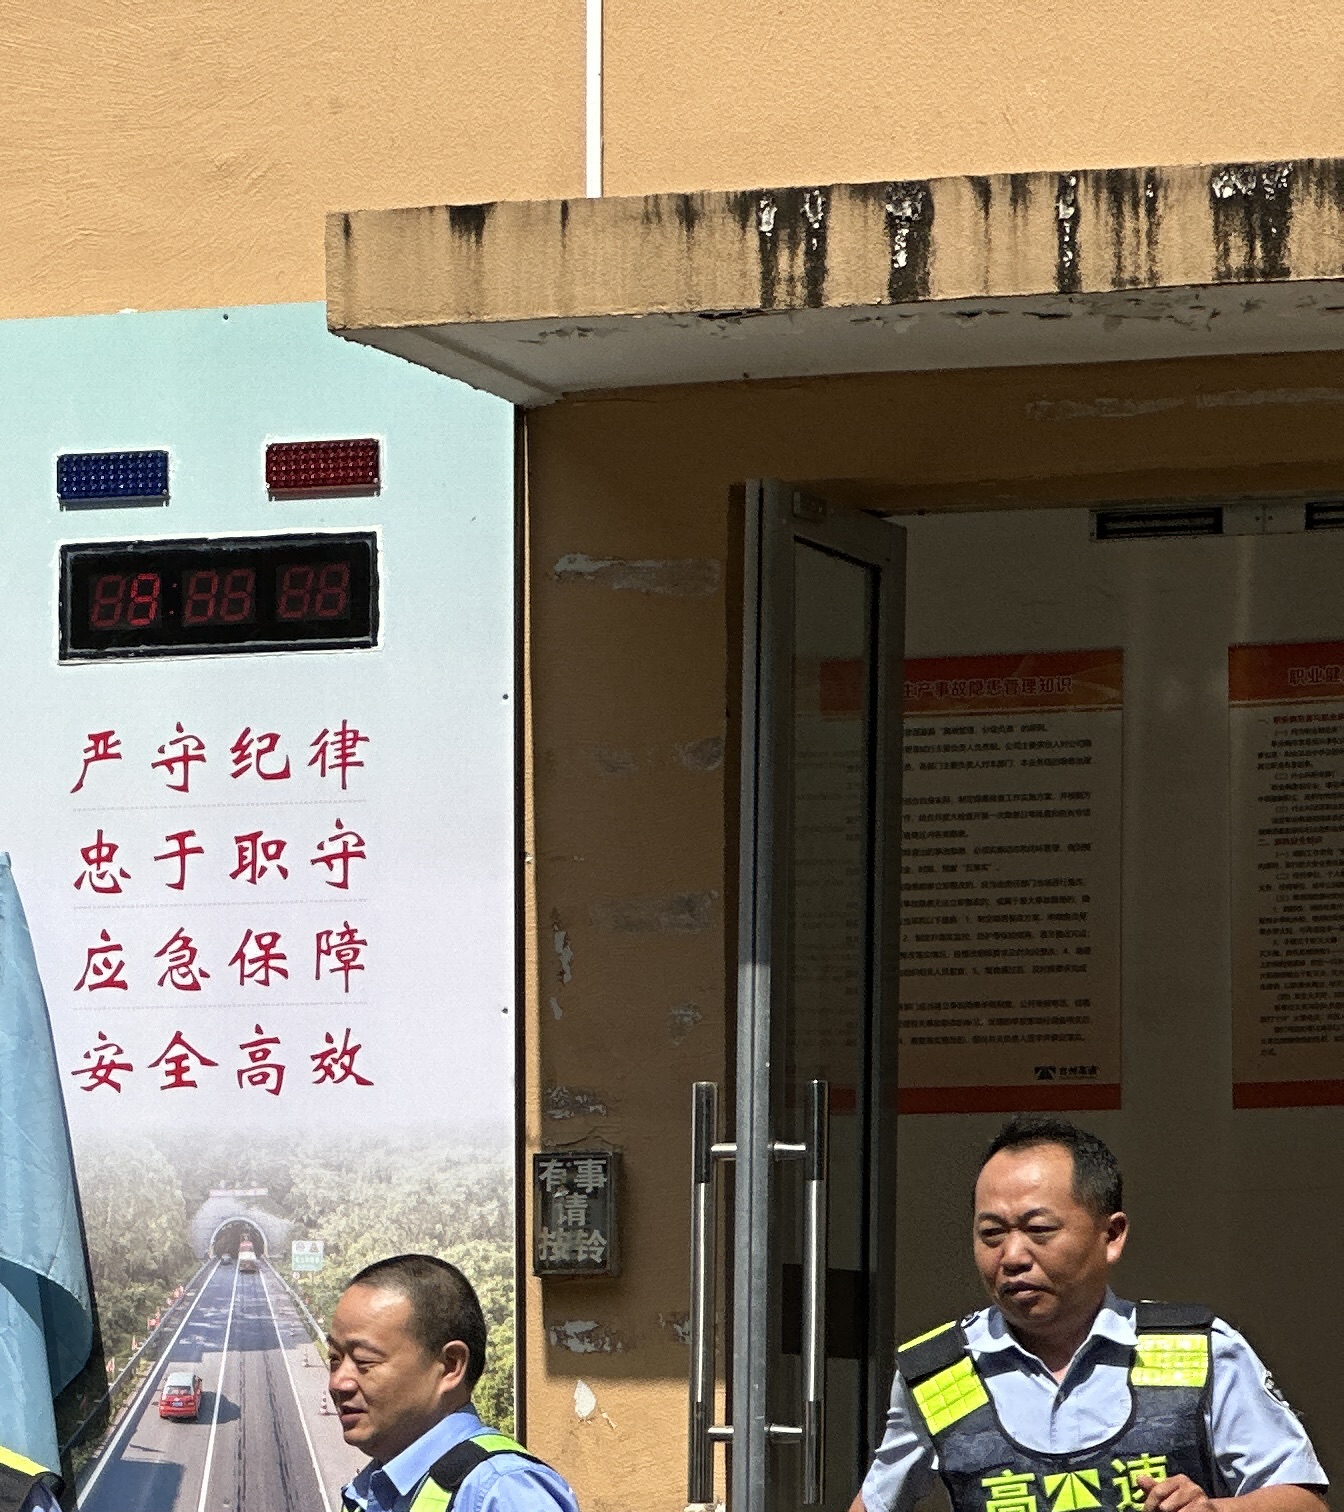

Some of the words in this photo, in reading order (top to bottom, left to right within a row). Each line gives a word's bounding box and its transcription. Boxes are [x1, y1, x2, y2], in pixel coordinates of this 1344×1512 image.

[70, 719, 370, 793] 严守纪律
[73, 819, 367, 893] 忠于职守
[73, 921, 368, 993] 应急保障
[71, 1024, 374, 1096] 安全高效
[539, 1158, 607, 1193] 有事
[553, 1192, 588, 1226] 请
